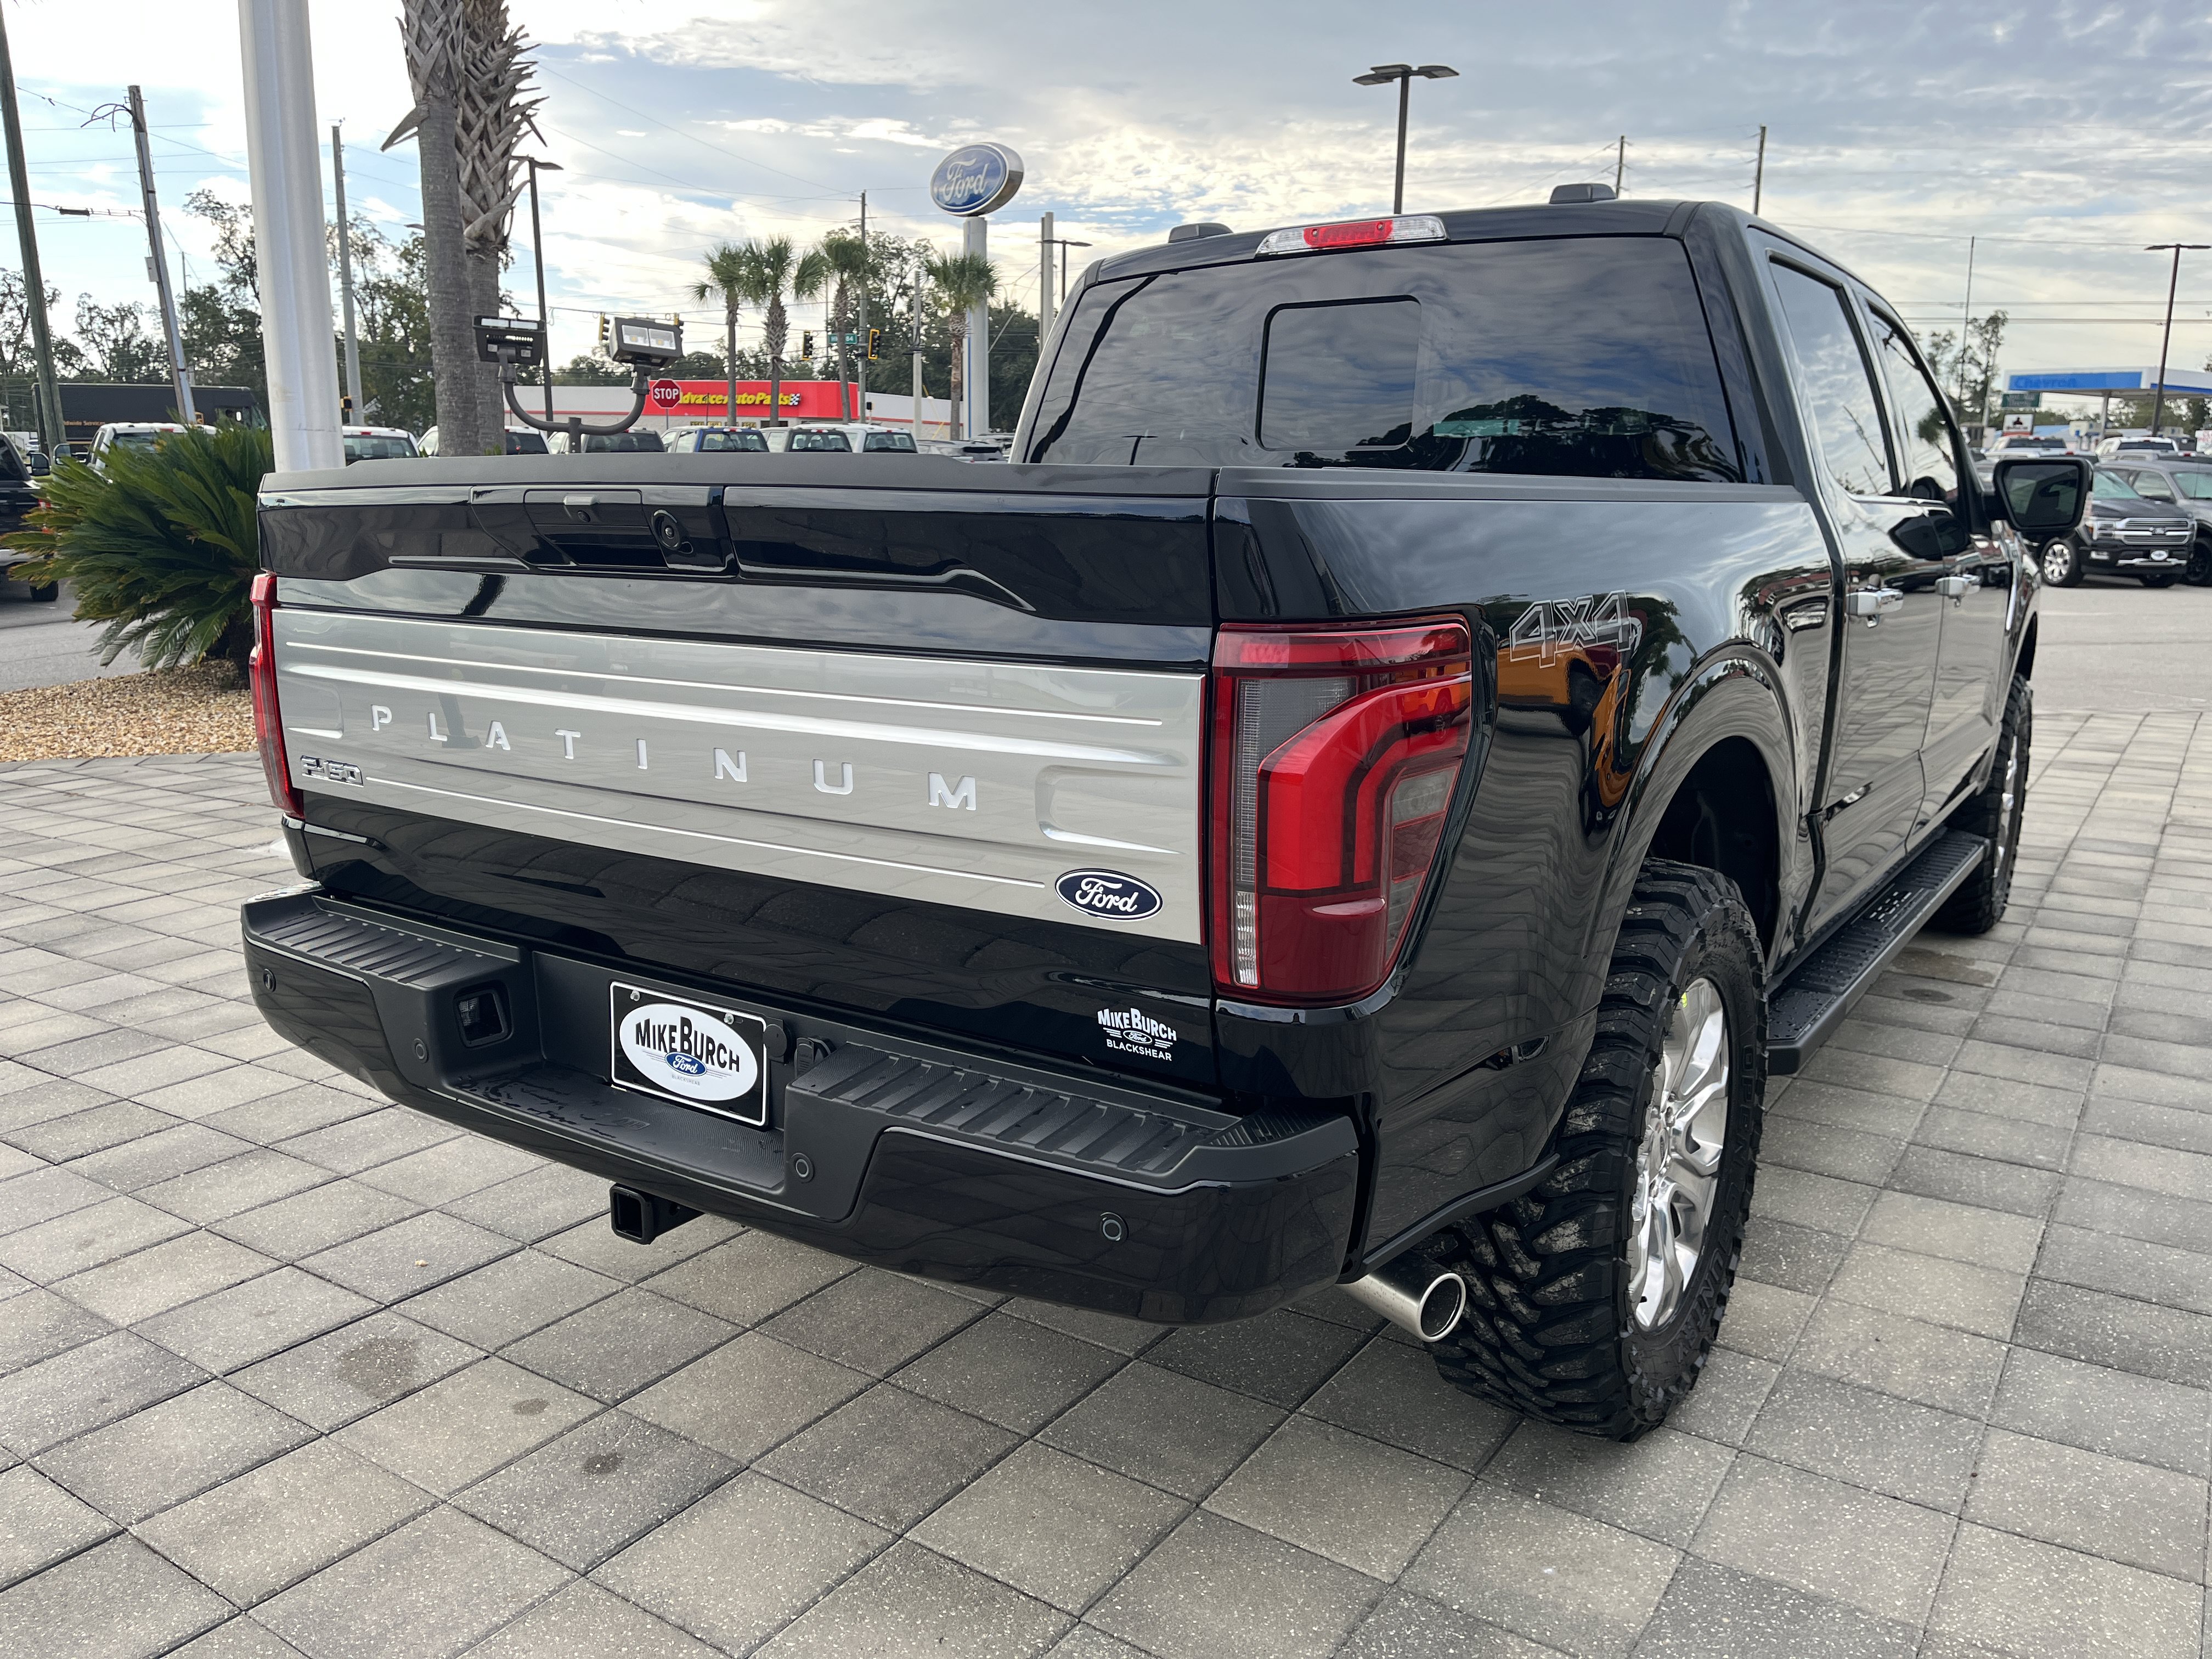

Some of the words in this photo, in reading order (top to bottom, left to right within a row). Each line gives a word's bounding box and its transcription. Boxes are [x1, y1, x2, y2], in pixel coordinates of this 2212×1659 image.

[943, 158, 989, 202] Ford
[653, 387, 679, 399] STOP
[755, 392, 789, 405] Pats
[371, 704, 977, 811] PLATINUM
[300, 755, 364, 787] F-150
[1075, 877, 1139, 912] Ford
[1128, 1032, 1147, 1042] Ford
[1106, 1039, 1172, 1062] BLACKSHEAR
[672, 1054, 698, 1074] Ford
[671, 1074, 701, 1086] BLACKSHEAR
